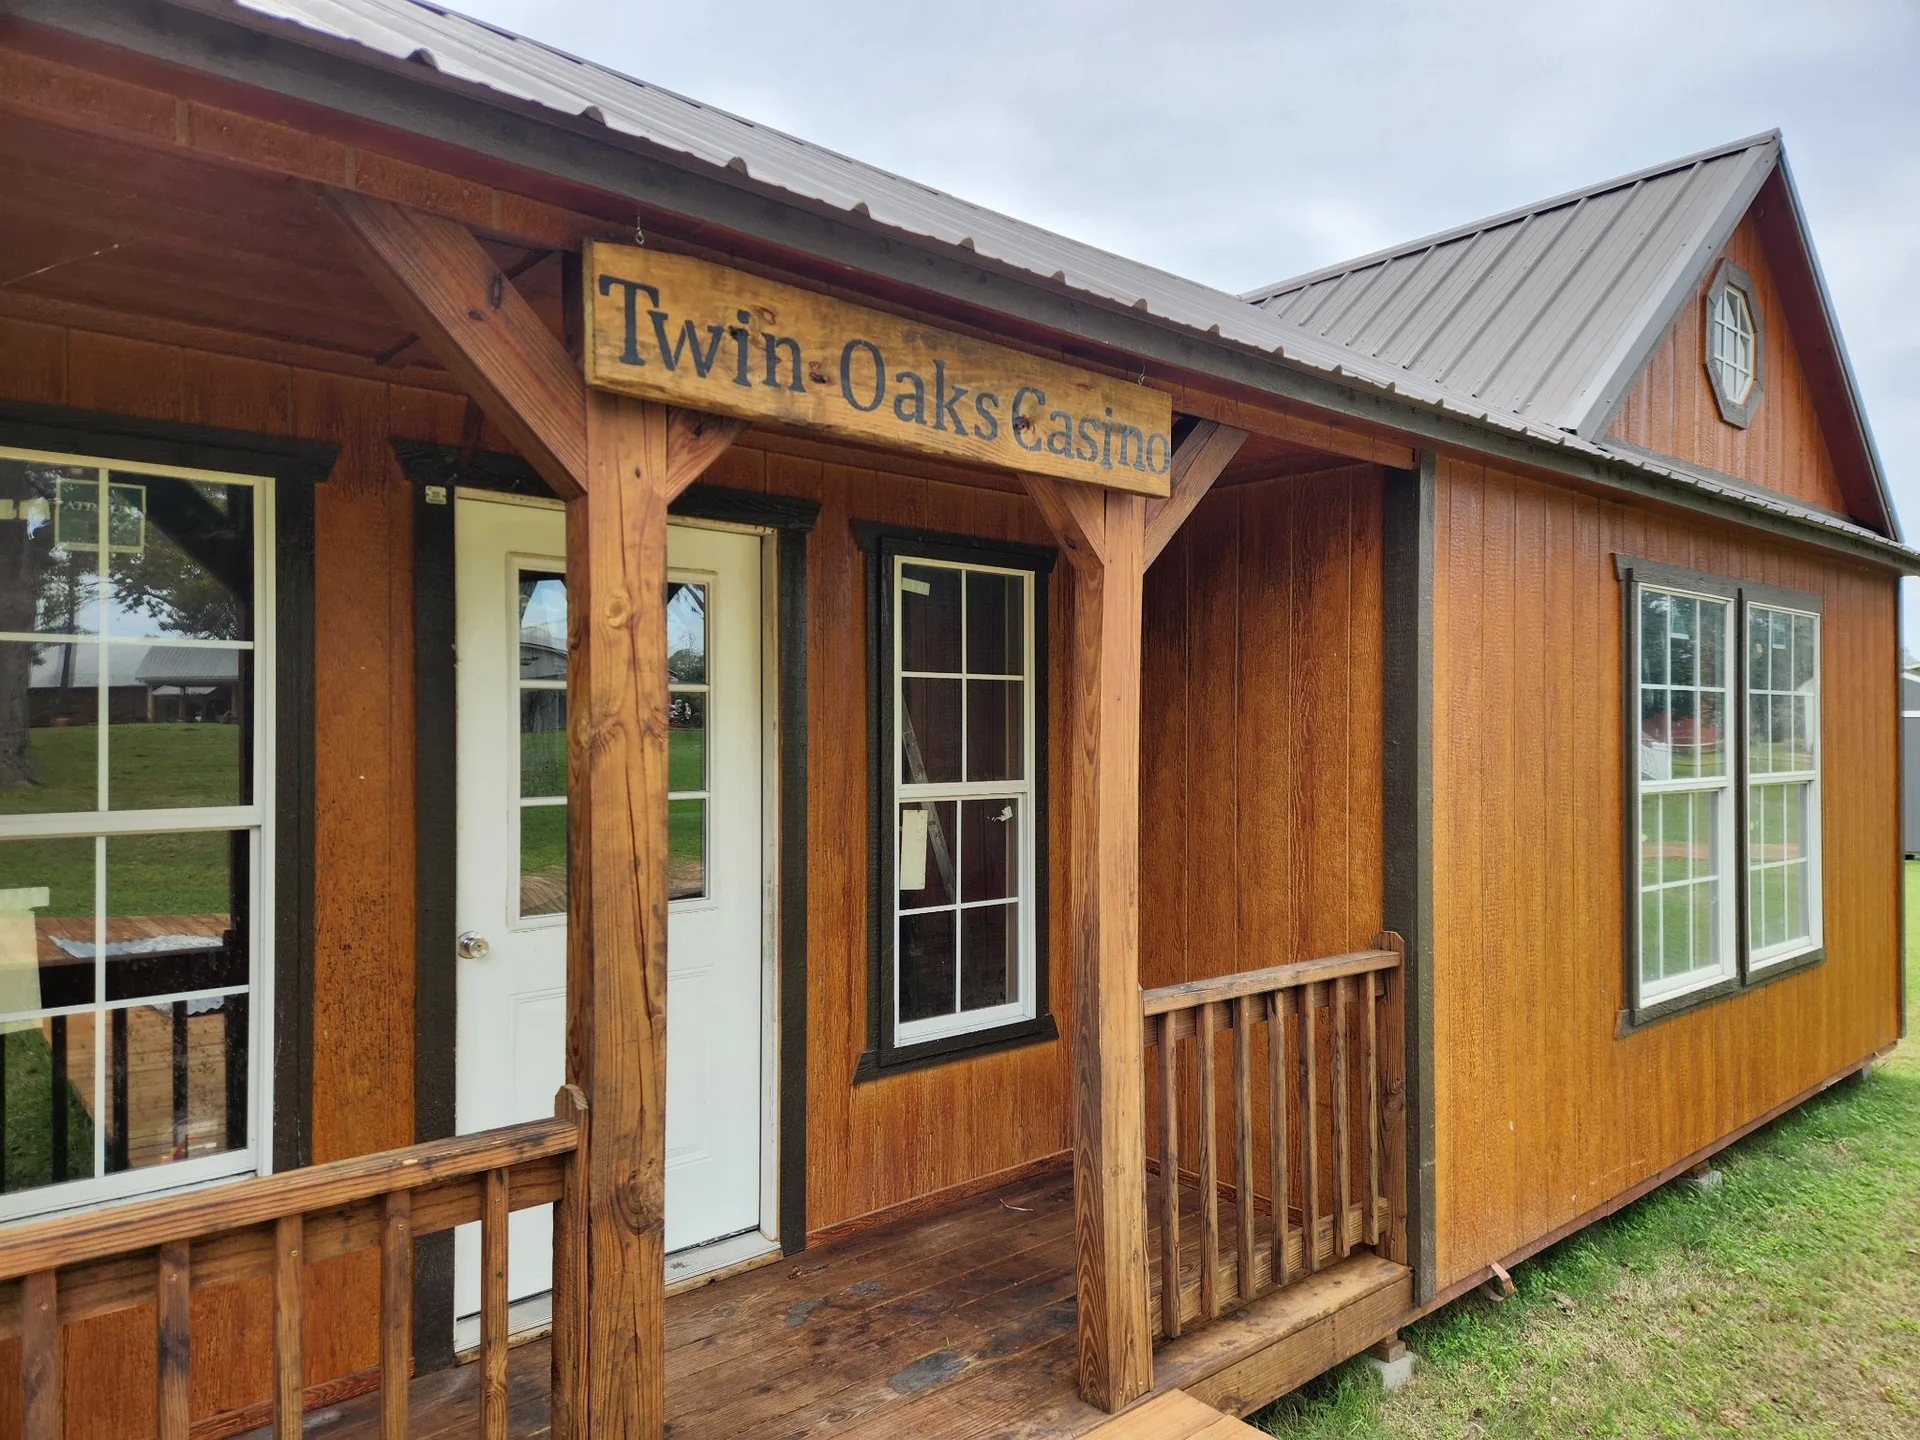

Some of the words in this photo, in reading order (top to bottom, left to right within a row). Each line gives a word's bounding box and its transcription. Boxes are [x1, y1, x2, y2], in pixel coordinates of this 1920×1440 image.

[599, 275, 807, 393] Twin
[839, 339, 1000, 441] Oaks
[1012, 386, 1170, 476] Casino
